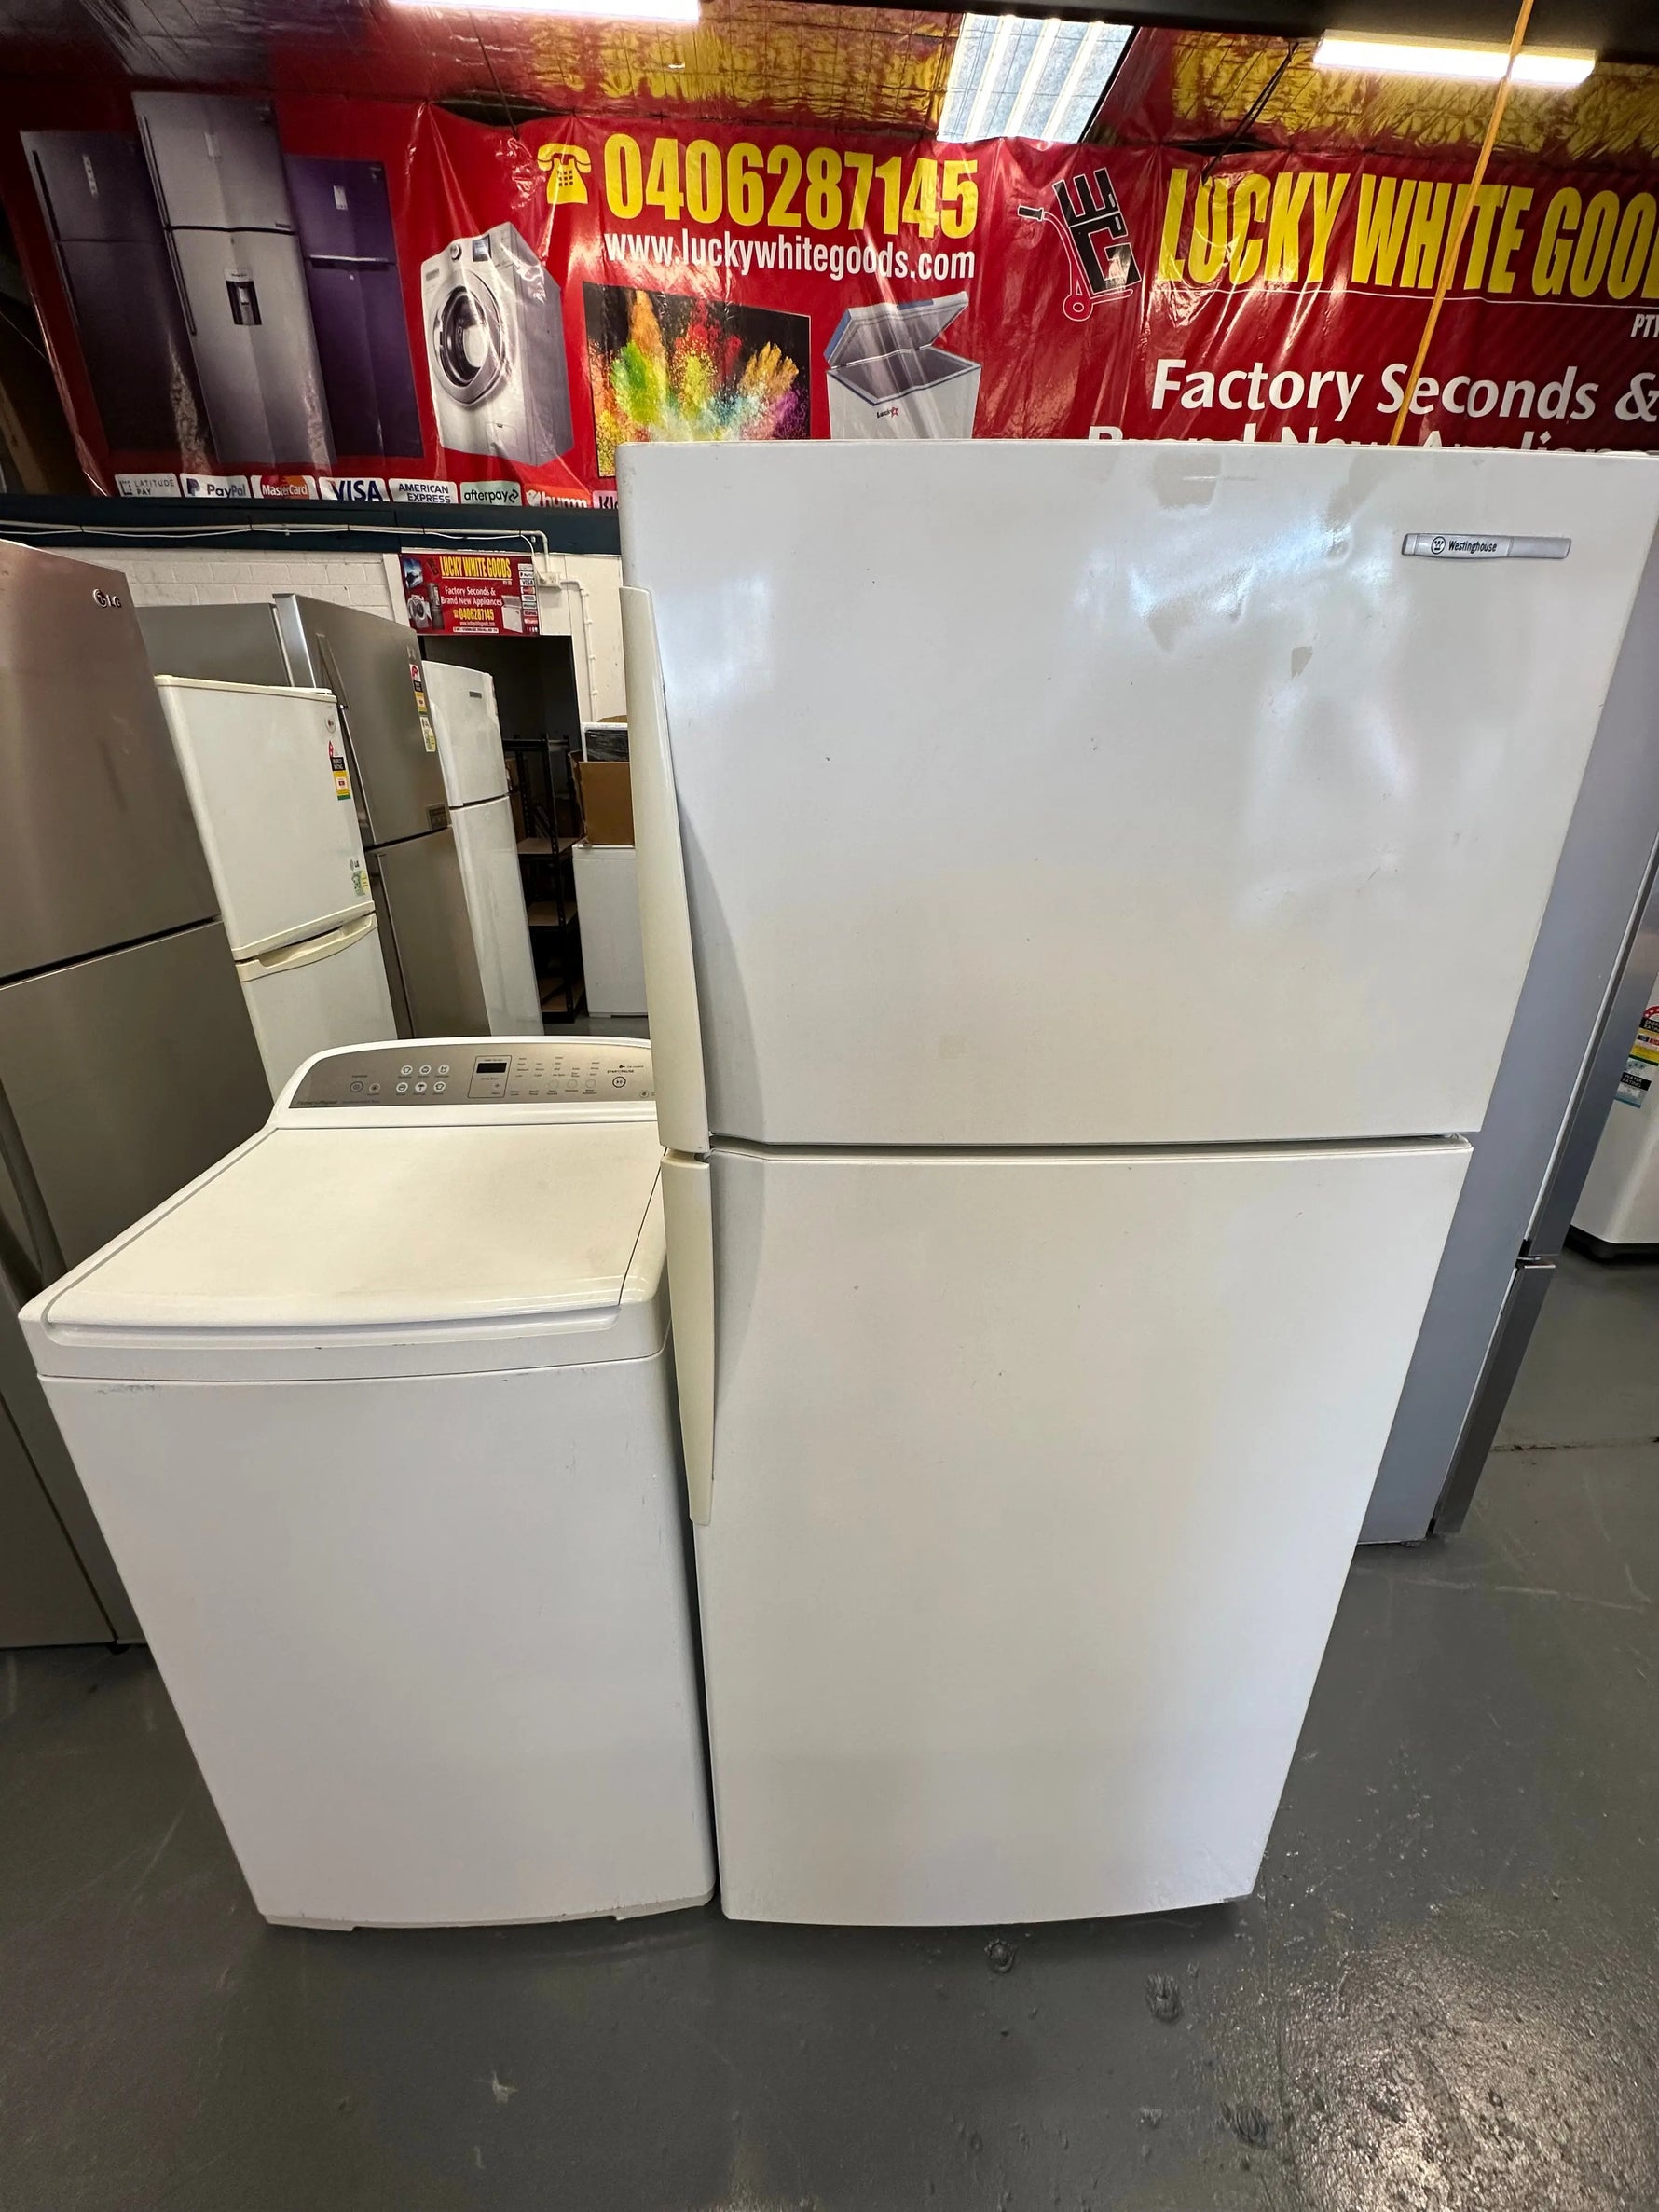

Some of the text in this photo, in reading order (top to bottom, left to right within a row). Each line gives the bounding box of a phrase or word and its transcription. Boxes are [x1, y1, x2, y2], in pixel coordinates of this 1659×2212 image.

[603, 132, 979, 239] 0406287145
[1157, 167, 1351, 285] LUCKY
[1351, 172, 1535, 294] WHITE
[603, 227, 977, 281] www.luckywhitegoods.com
[1151, 358, 1659, 422] Factory Seconds &
[134, 478, 175, 488] LATITUDE
[207, 483, 247, 498] PayPal
[261, 483, 308, 497] MasterCard
[330, 479, 383, 502] VISA
[398, 483, 449, 494] AMERICAN
[136, 488, 152, 497] PAY
[407, 491, 451, 504] EXPRESS
[463, 489, 508, 504] afterpay
[542, 491, 588, 509] humm
[1448, 539, 1498, 554] Westinghouse
[439, 556, 512, 579] LUCKY WHITE GOODS
[445, 586, 466, 597] Factory
[466, 587, 490, 597] Seconds
[440, 596, 503, 608] Brand New Appliances
